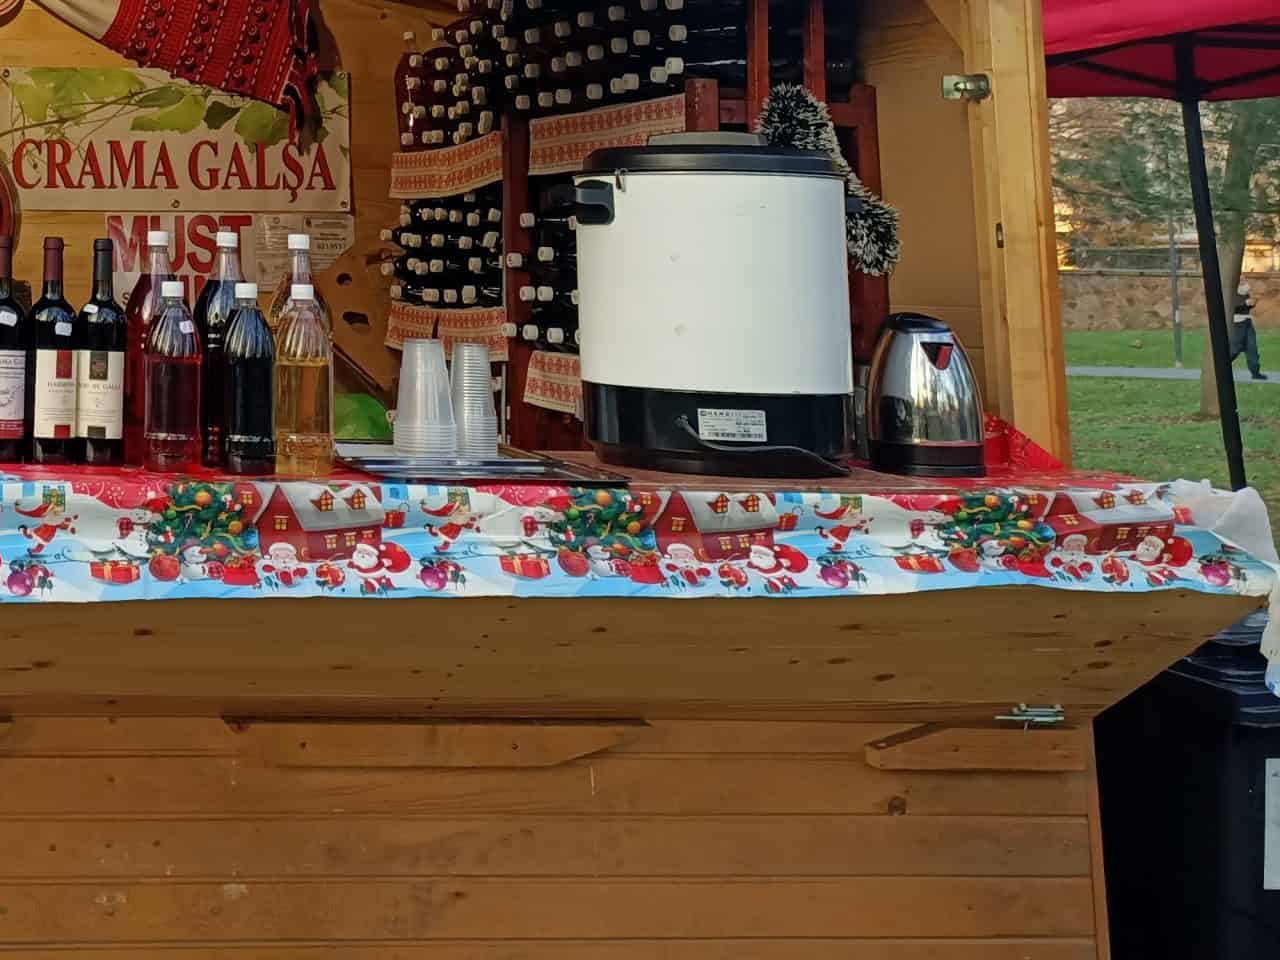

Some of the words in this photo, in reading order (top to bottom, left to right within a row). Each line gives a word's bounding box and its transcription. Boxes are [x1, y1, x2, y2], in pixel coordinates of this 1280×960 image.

[12, 137, 180, 190] CRAMA
[188, 139, 337, 203] GALȘA
[107, 214, 252, 273] MUST
